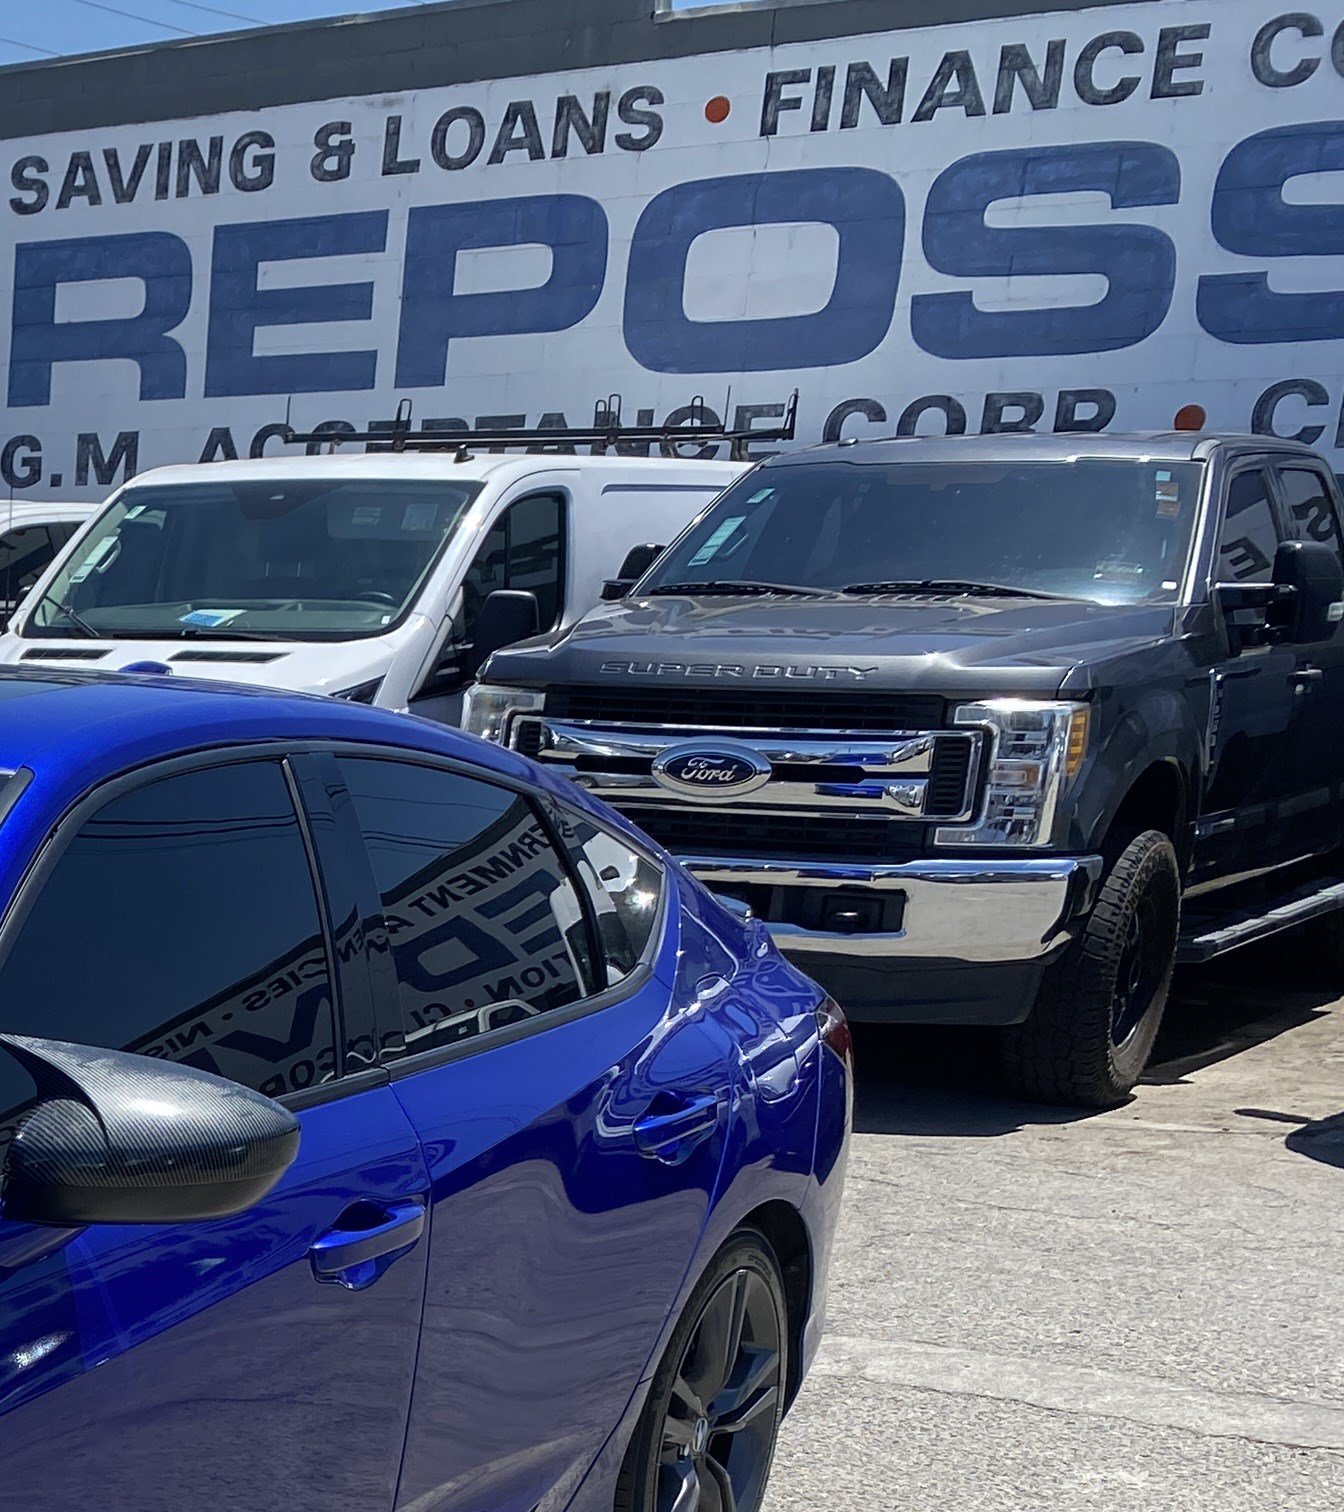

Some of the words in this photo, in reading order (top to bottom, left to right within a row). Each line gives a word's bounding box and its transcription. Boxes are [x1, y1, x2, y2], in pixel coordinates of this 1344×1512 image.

[9, 130, 276, 215] SAVING
[312, 121, 354, 182] &
[383, 85, 665, 176] LOANS
[760, 23, 1212, 138] FINANCE
[1251, 12, 1344, 88] C
[1251, 377, 1344, 448] C
[598, 660, 745, 678] SUPER
[752, 664, 879, 681] DUTY
[681, 756, 736, 781] Ford
